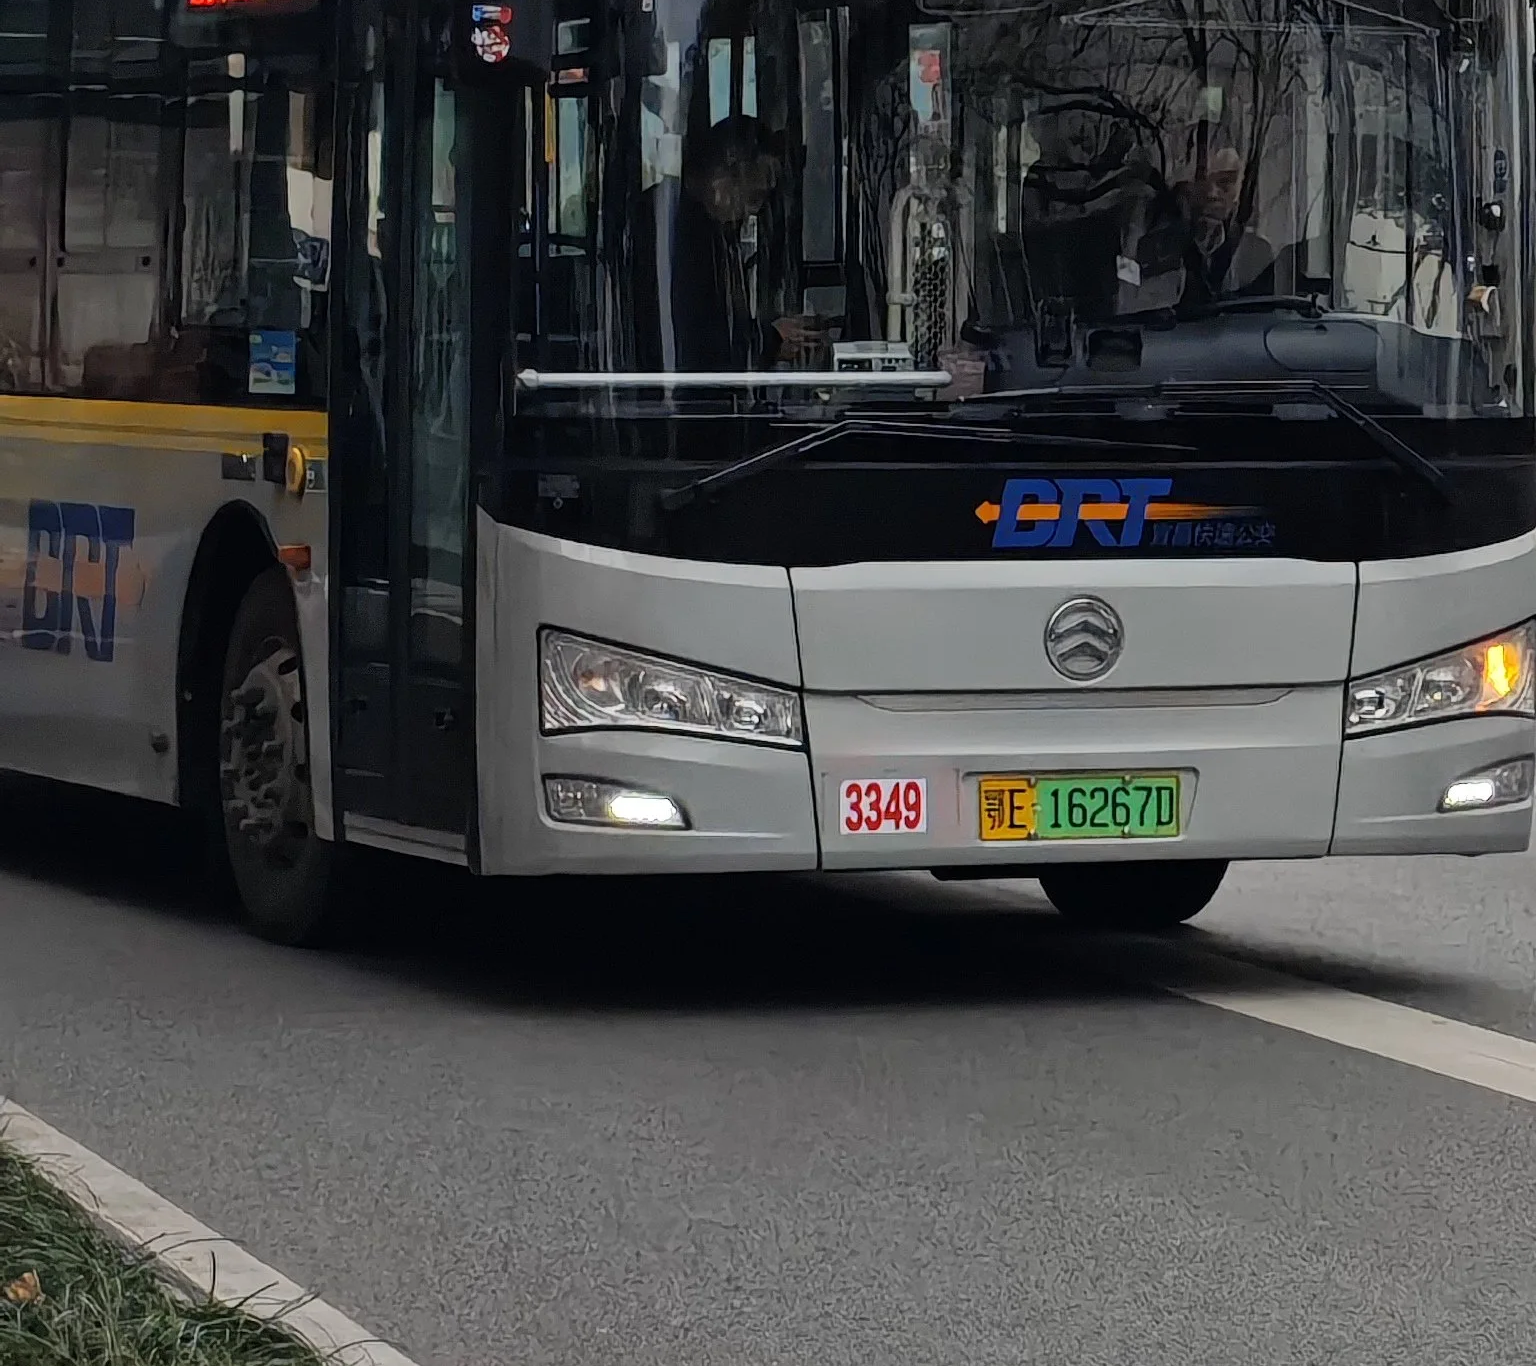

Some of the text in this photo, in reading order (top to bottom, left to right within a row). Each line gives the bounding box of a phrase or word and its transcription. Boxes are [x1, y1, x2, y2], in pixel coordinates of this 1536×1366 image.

[992, 478, 1172, 548] BRT
[22, 498, 136, 662] BRT
[844, 781, 923, 832] 3349
